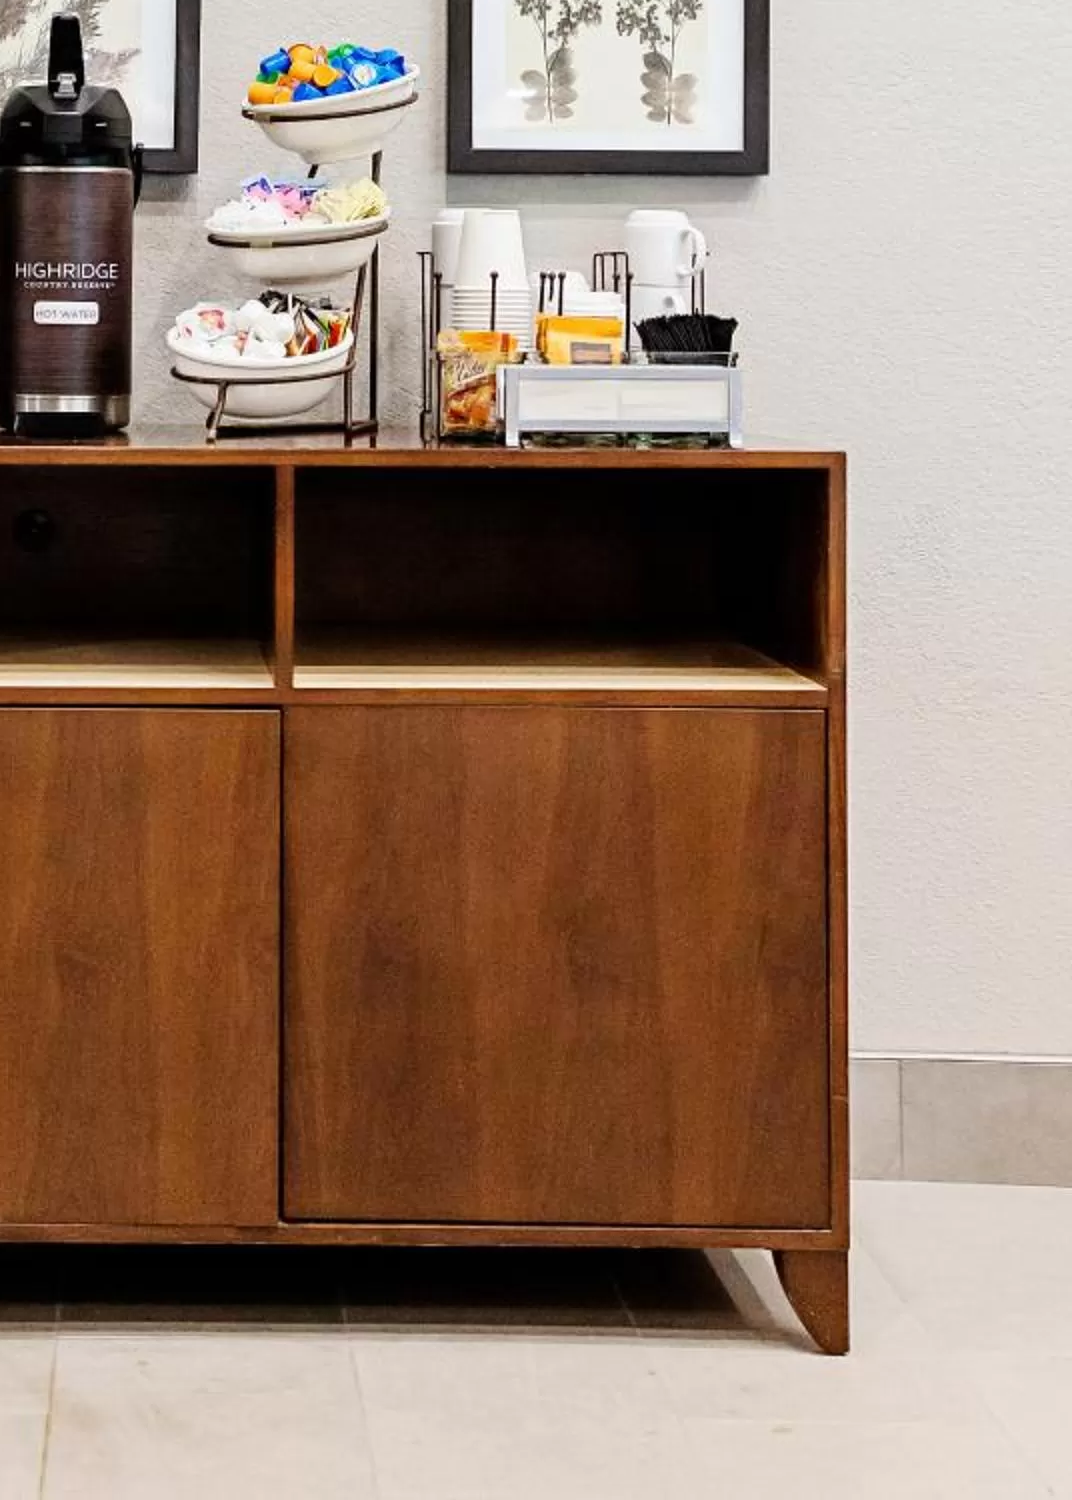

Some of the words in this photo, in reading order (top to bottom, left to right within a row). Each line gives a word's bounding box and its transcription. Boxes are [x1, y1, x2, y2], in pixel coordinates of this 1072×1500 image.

[15, 262, 120, 279] HIGHRIDGE
[36, 309, 57, 319] HOT
[60, 309, 96, 319] WATER
